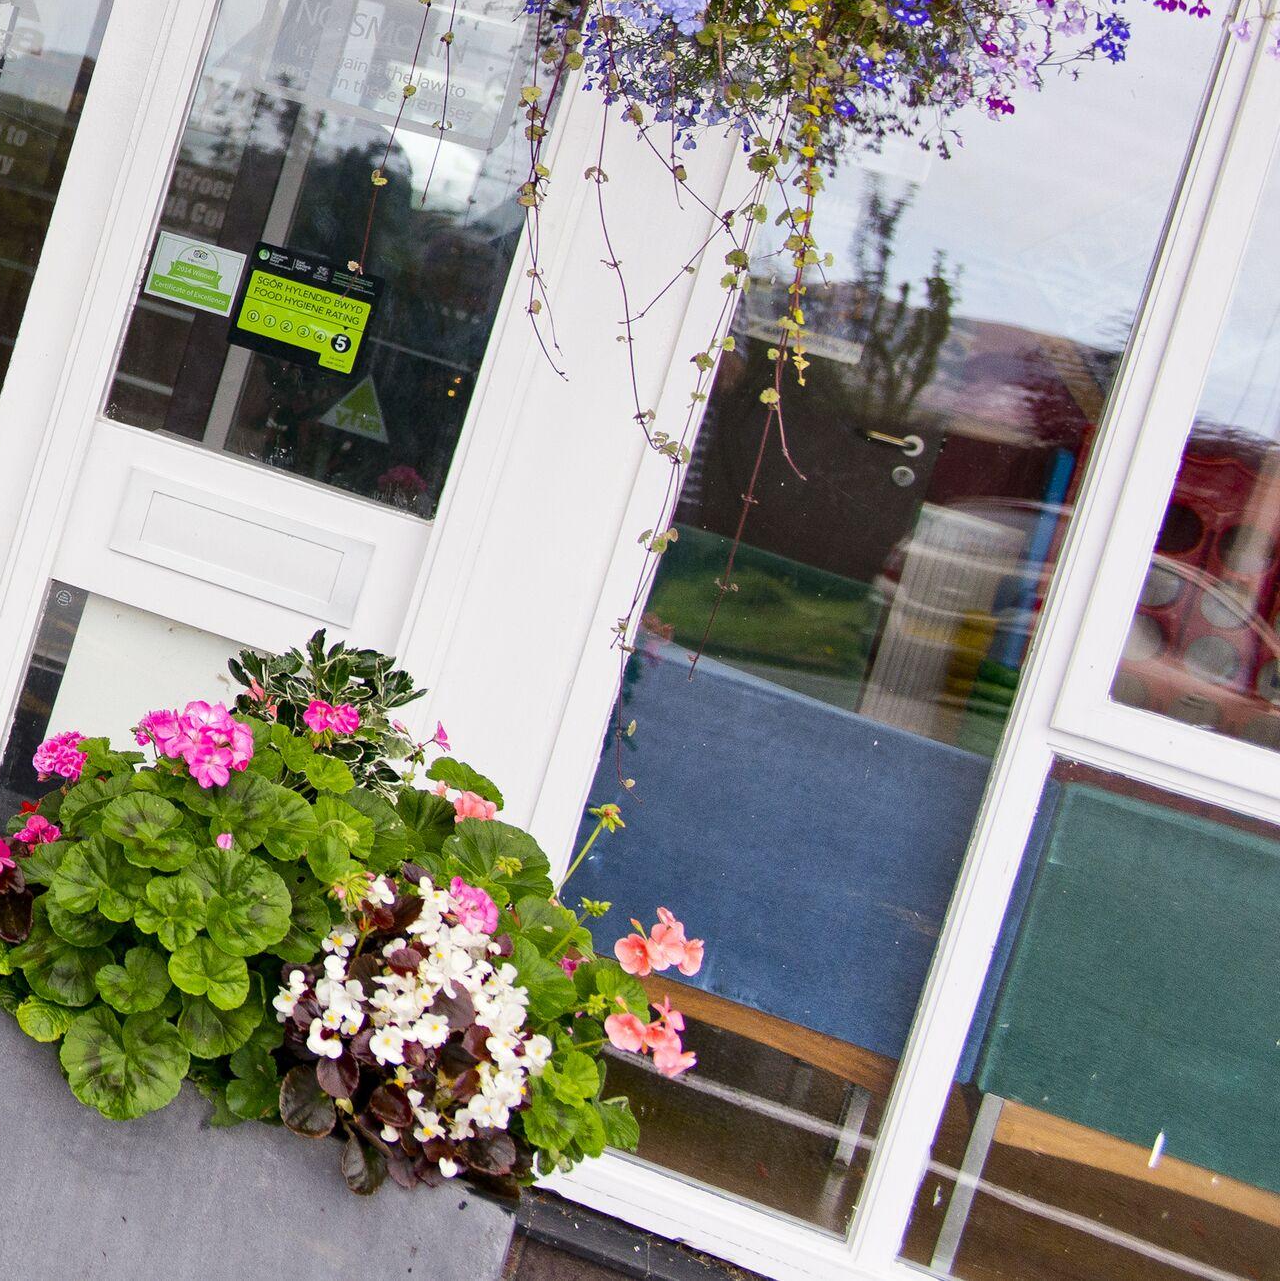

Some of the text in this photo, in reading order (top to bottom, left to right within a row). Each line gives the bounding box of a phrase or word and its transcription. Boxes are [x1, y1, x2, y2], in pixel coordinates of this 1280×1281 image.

[416, 72, 446, 93] law
[449, 83, 466, 98] to
[177, 265, 215, 280] 2014 Winner
[155, 280, 186, 295] Certificate
[194, 291, 226, 306] Excellence
[254, 287, 360, 325] FOOD HYGIENE RATING
[285, 284, 332, 304] HYLENDID
[334, 298, 363, 314] BWYD
[334, 335, 347, 352] 5
